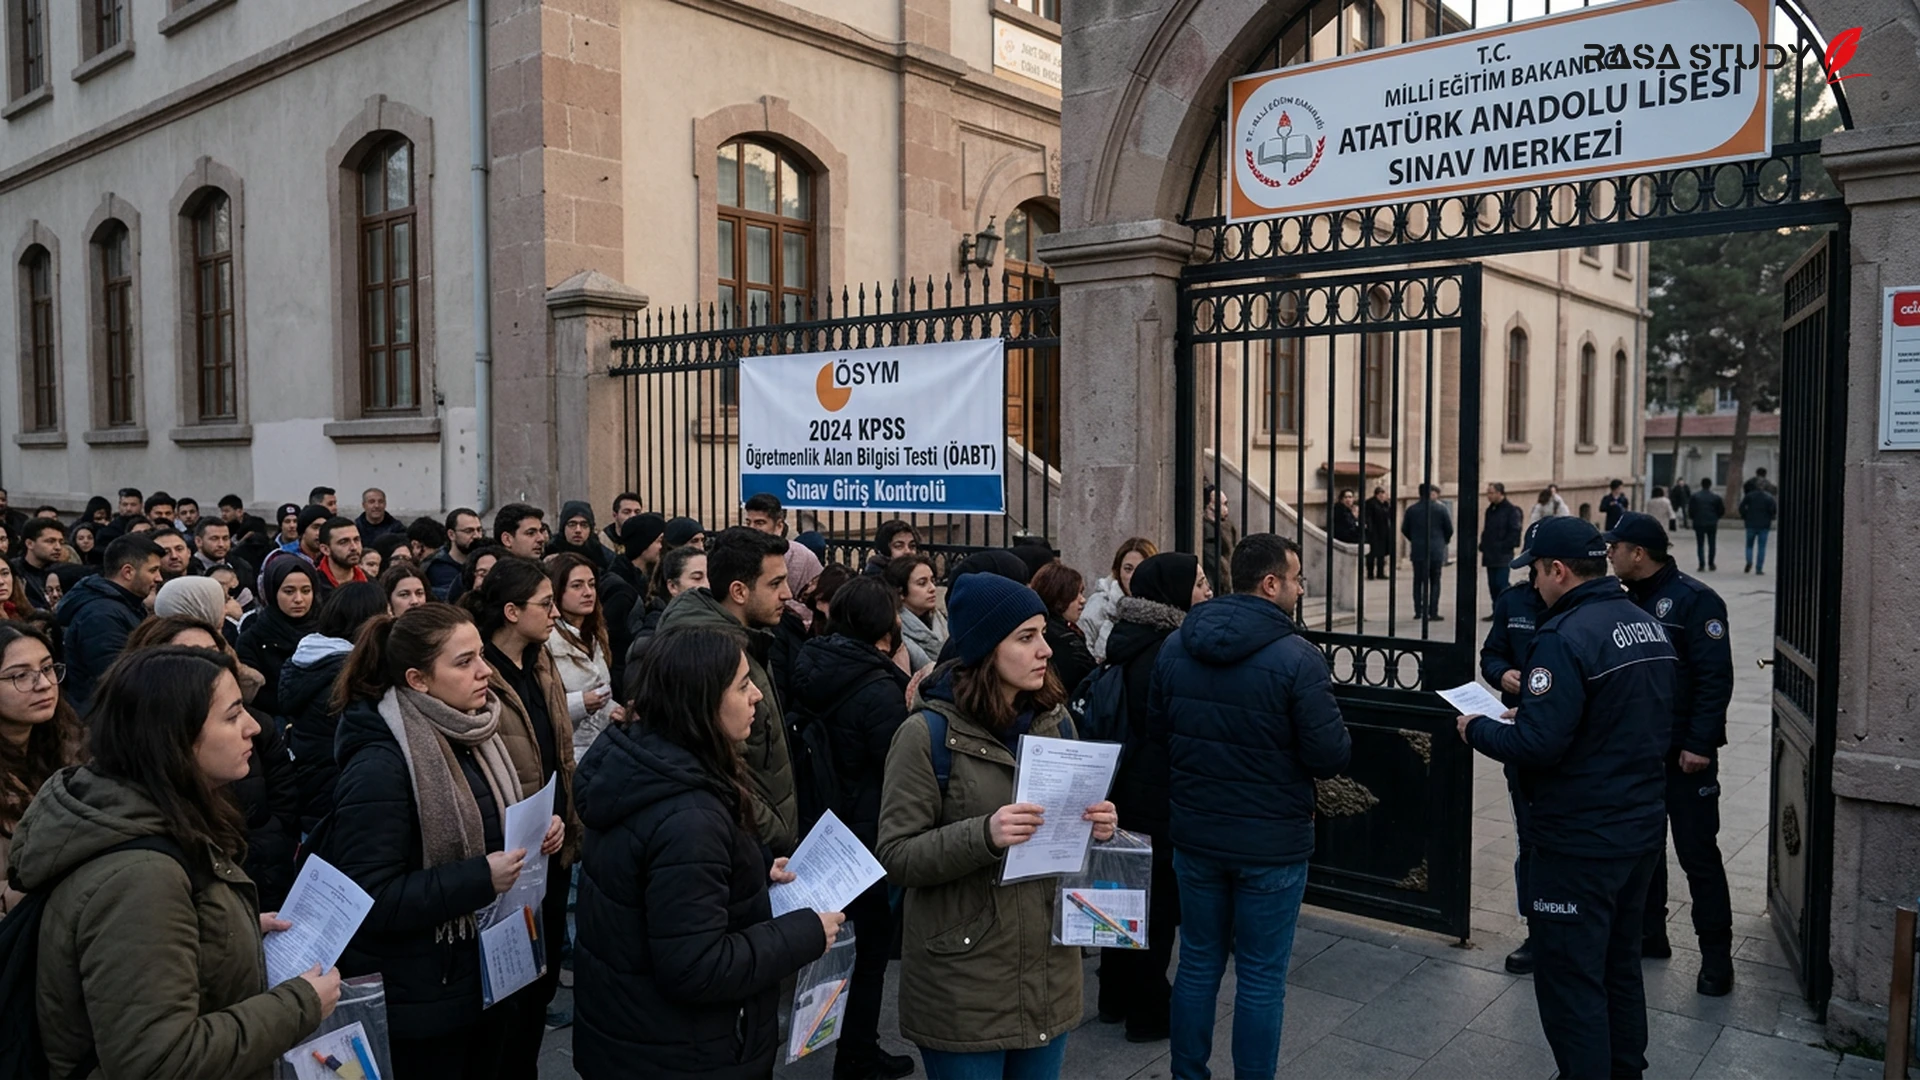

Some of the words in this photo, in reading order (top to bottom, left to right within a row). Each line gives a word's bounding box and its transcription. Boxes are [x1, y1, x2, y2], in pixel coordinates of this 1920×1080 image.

[1477, 43, 1511, 65] T.C.
[1385, 78, 1434, 108] MİLLİ
[1439, 68, 1506, 98] EĞİTİM
[1511, 45, 1626, 87] BAKANLĞ
[1338, 109, 1464, 155] ATATÜRK
[1469, 82, 1628, 135] ANADOLU
[1638, 57, 1742, 110] LİSESİ
[1388, 148, 1476, 186] SINAV
[1482, 119, 1623, 173] MERKEZİ
[835, 358, 900, 386] ÖSYM
[809, 419, 853, 442] 2024
[858, 416, 906, 442] KPSS
[745, 443, 820, 470] Öğretmenlik
[824, 447, 853, 467] Alan
[857, 447, 900, 470] Bilgisi
[904, 446, 938, 466] Testi
[943, 440, 997, 470] (ÖABT)
[786, 477, 829, 501] Sınav
[833, 478, 870, 506] Giriş
[874, 478, 947, 503] Kontrolü
